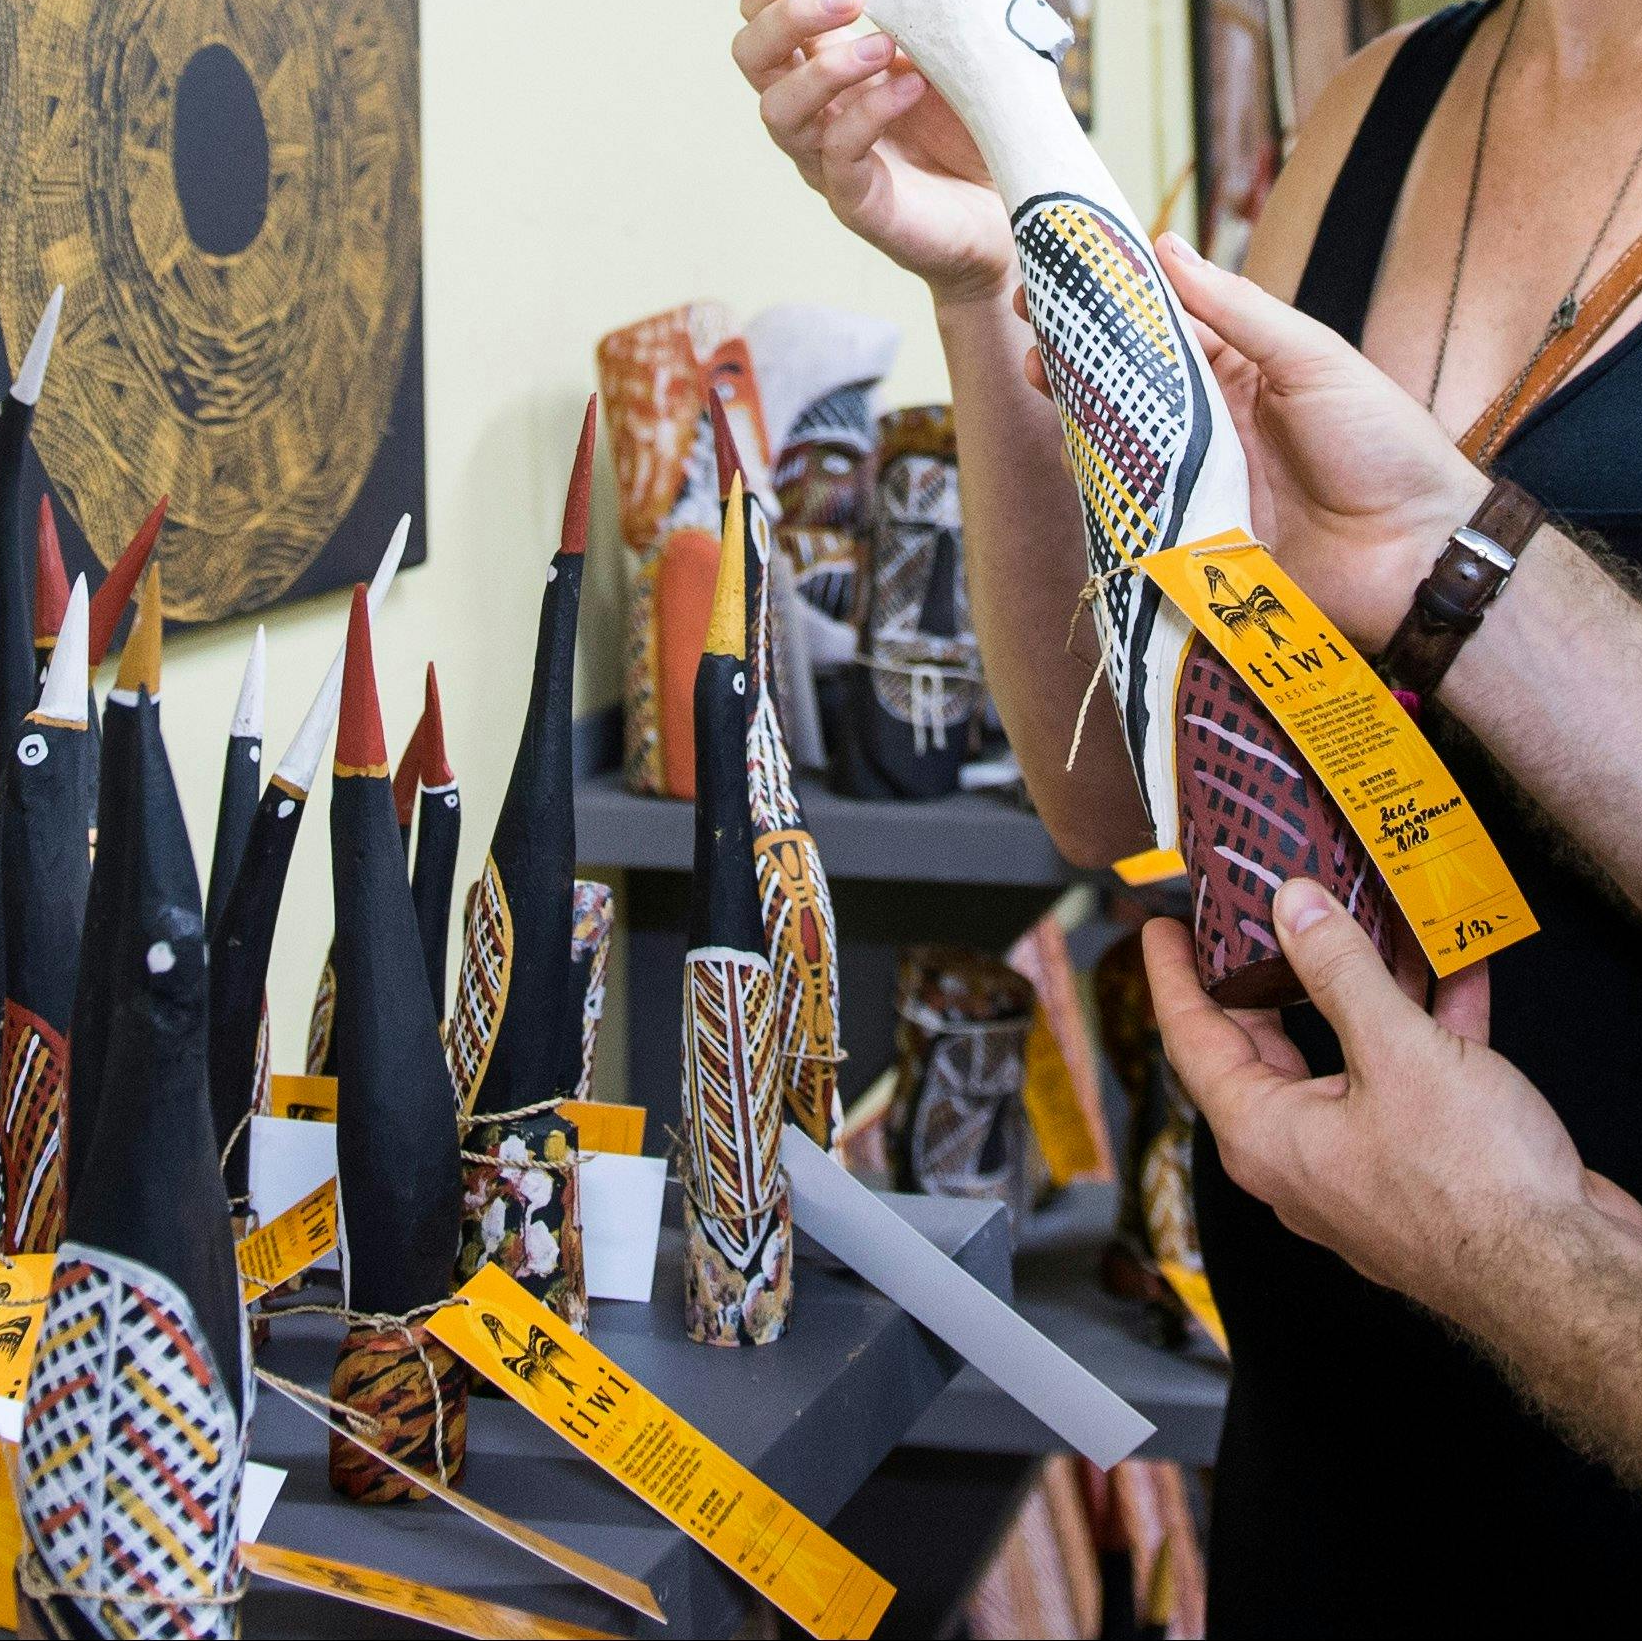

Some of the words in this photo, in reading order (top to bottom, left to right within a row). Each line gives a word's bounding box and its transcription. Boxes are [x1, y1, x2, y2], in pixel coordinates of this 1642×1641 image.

[1247, 632, 1349, 688] tiwi
[1274, 678, 1328, 705] DESIGN
[1396, 826, 1429, 853] BIRD
[560, 1366, 630, 1439] tiwi
